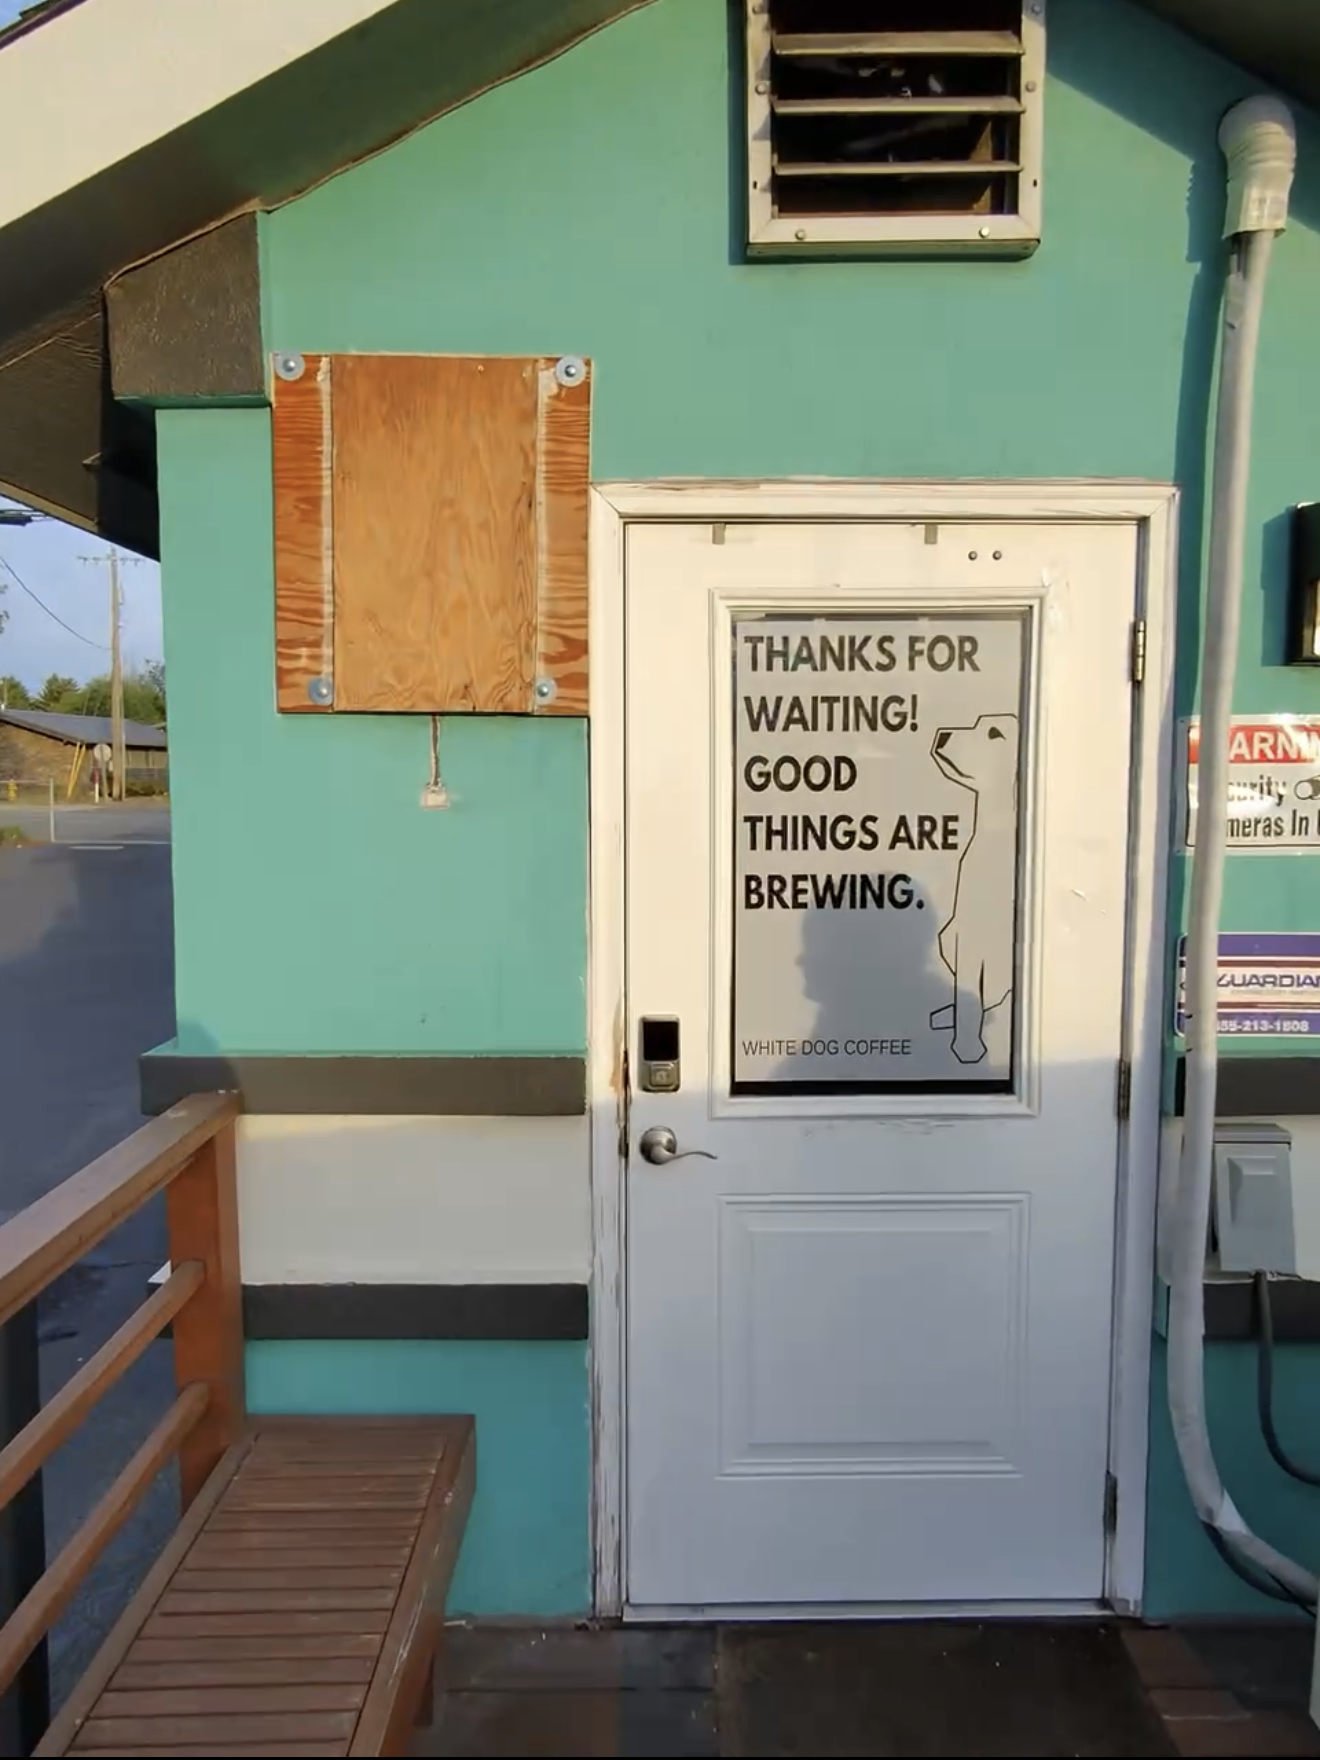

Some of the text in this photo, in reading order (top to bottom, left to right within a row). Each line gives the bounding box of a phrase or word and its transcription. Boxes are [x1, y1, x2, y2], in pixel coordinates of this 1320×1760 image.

[743, 635, 981, 672] THANKS FOR
[743, 694, 919, 732] WAITING!
[743, 755, 858, 792] GOOD
[743, 814, 959, 851] THINGS ARE
[1226, 815, 1285, 838] meras
[1291, 809, 1309, 836] In
[744, 873, 925, 910] BREWING.
[1216, 973, 1320, 988] GUARDIA
[742, 1039, 912, 1056] WHITE DOG COFFEE
